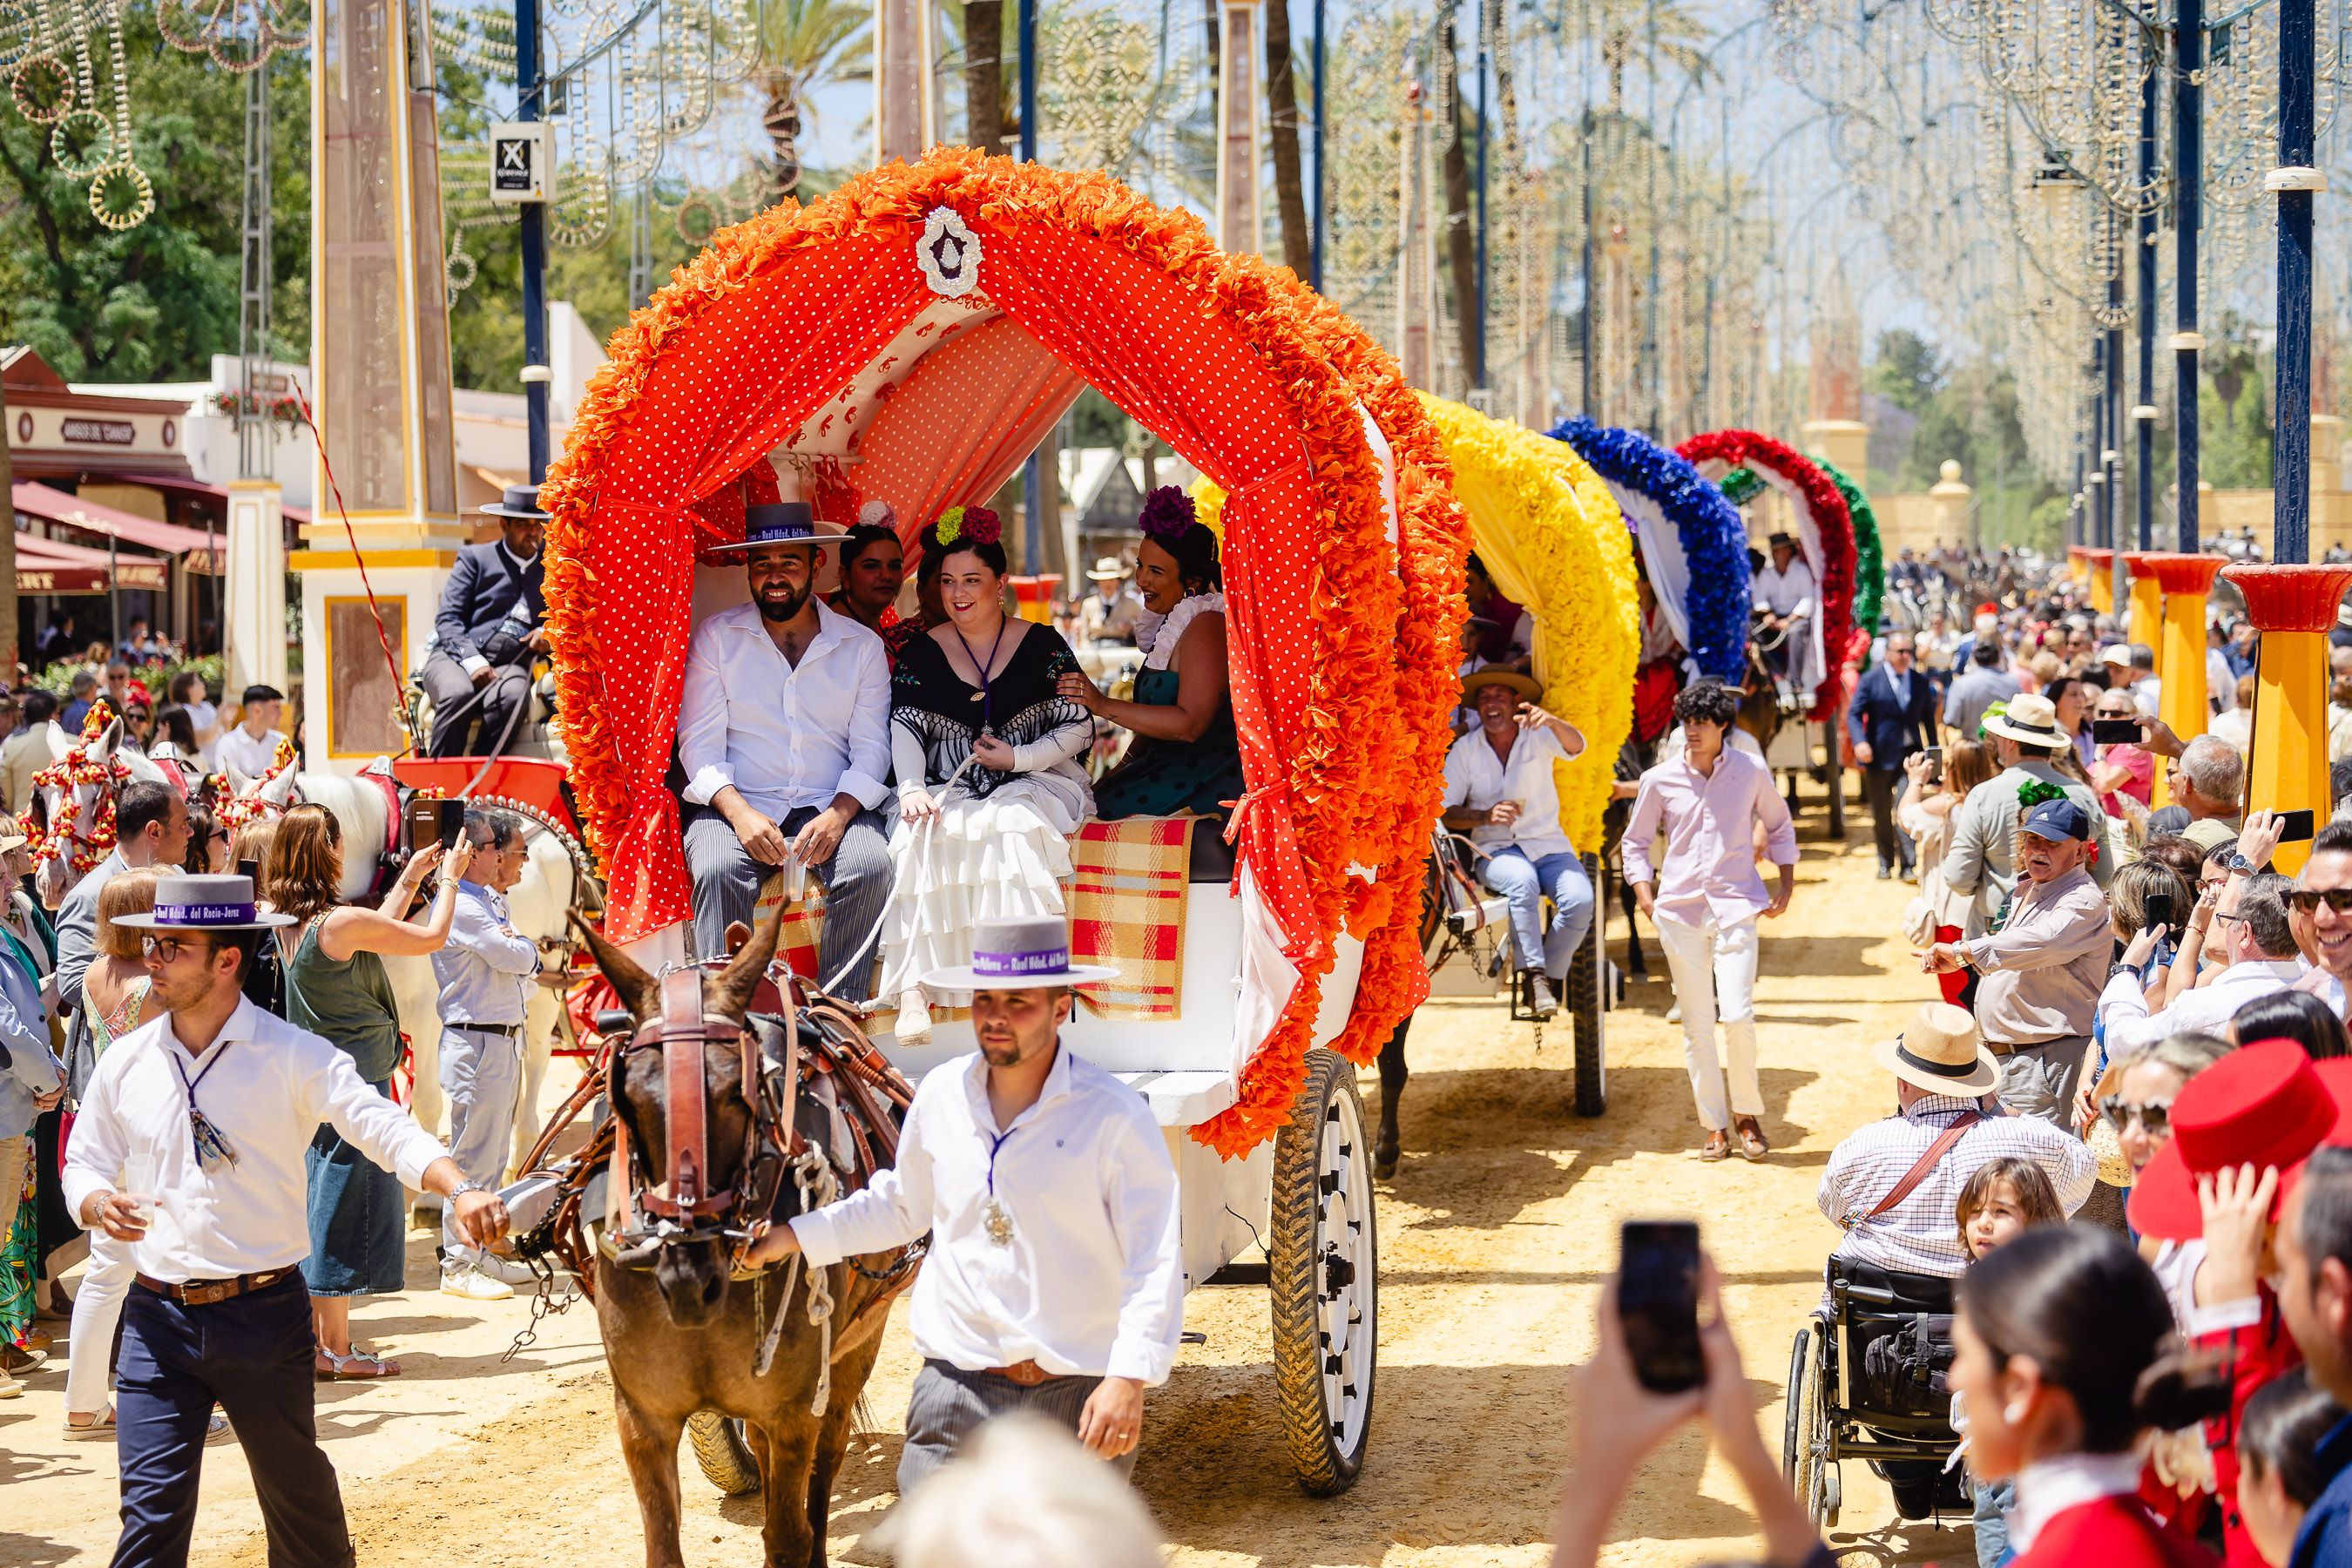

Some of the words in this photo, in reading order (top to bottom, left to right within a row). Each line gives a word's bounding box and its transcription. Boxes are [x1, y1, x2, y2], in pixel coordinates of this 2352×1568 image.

[503, 140, 525, 170] X
[762, 530, 774, 540] Real
[774, 528, 790, 538] Hdad.
[169, 906, 188, 919] Hdad.
[191, 907, 201, 919] del
